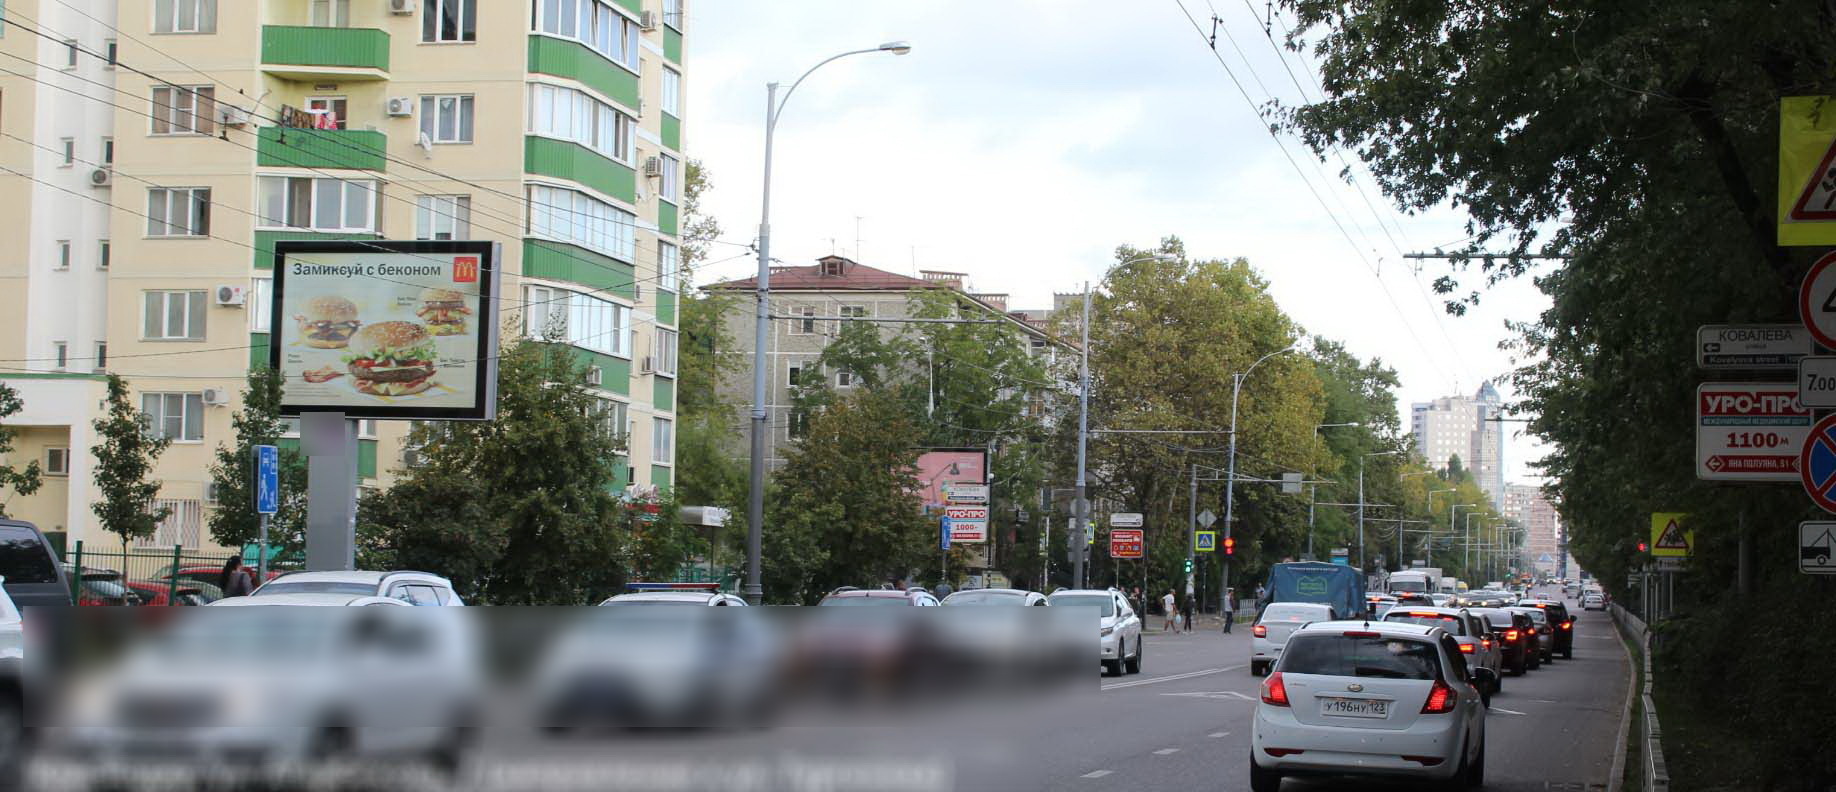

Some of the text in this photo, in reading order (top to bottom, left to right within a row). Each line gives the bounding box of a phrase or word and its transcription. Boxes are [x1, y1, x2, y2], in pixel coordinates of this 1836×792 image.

[293, 263, 441, 278] Замиксуй с беконом
[1719, 329, 1793, 341] КОВАЛЕВА
[948, 510, 985, 518] УРО-ПРО
